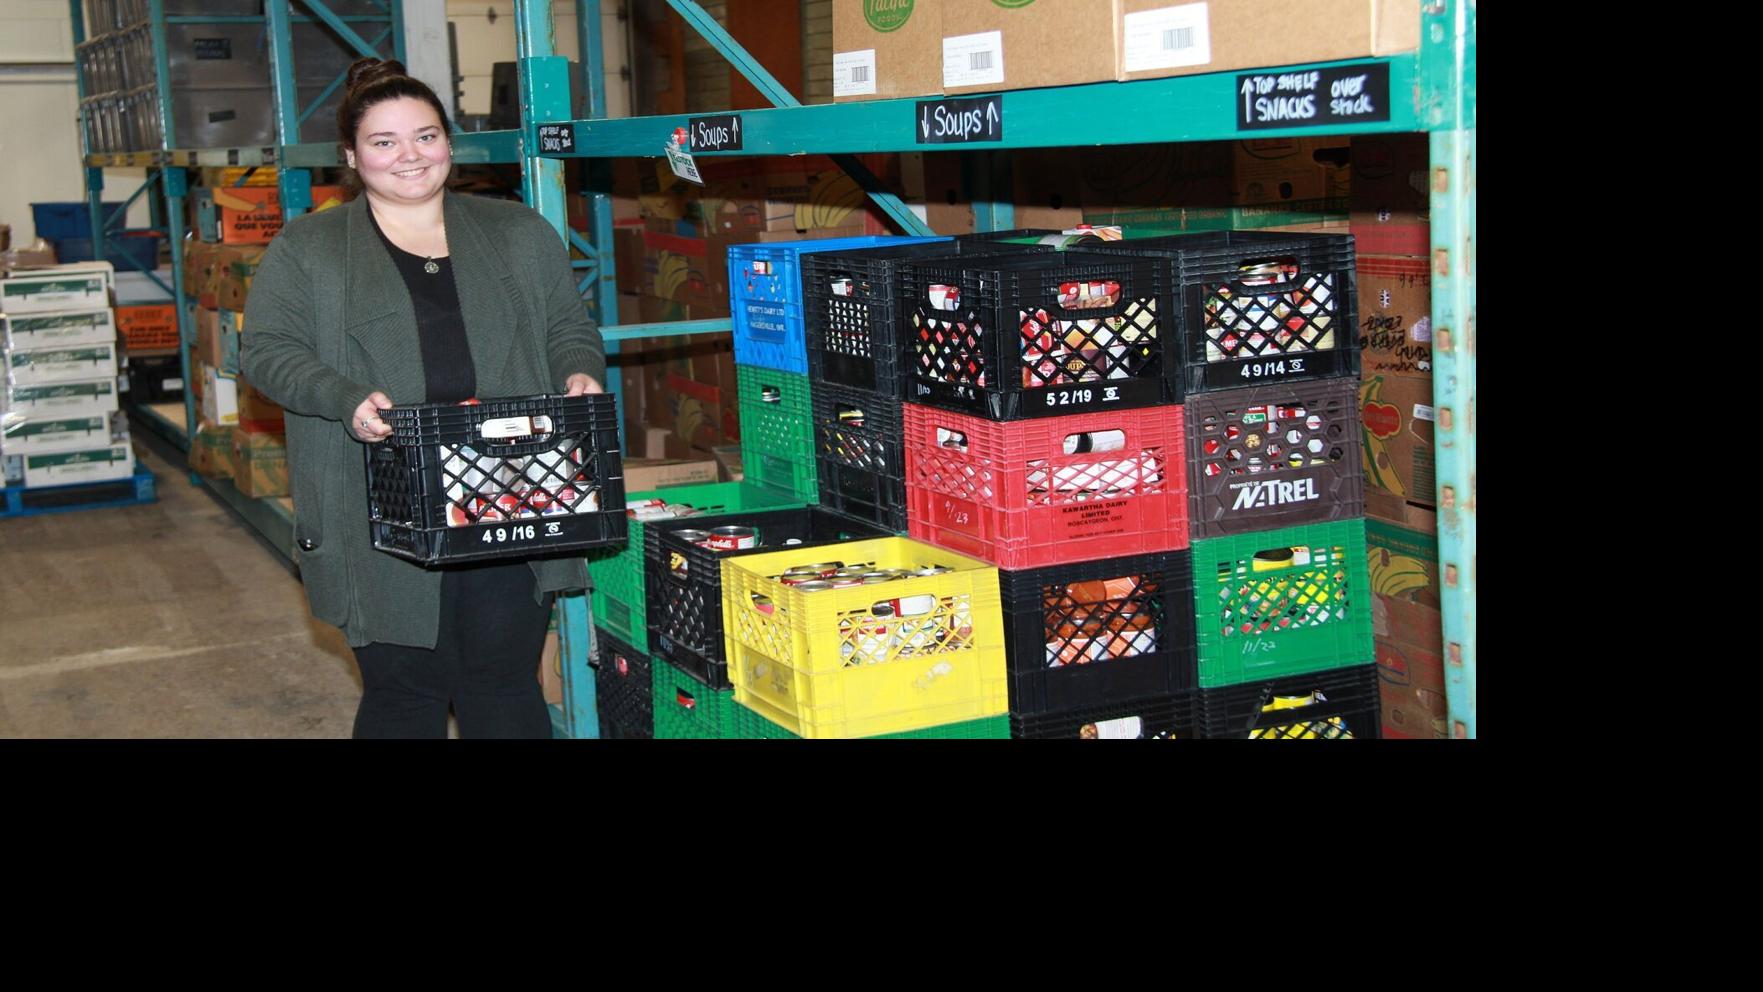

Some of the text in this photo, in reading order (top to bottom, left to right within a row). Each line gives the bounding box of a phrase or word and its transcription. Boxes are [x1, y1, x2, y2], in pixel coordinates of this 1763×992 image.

[1253, 71, 1320, 94] TOP SHELF
[1255, 95, 1316, 122] SNACKS
[699, 121, 729, 150] Soups
[935, 105, 982, 140] Soups
[1062, 500, 1127, 513] KAWARTHA DAIRY
[1232, 478, 1319, 510] NATREL
[1081, 510, 1110, 518] LIMITED
